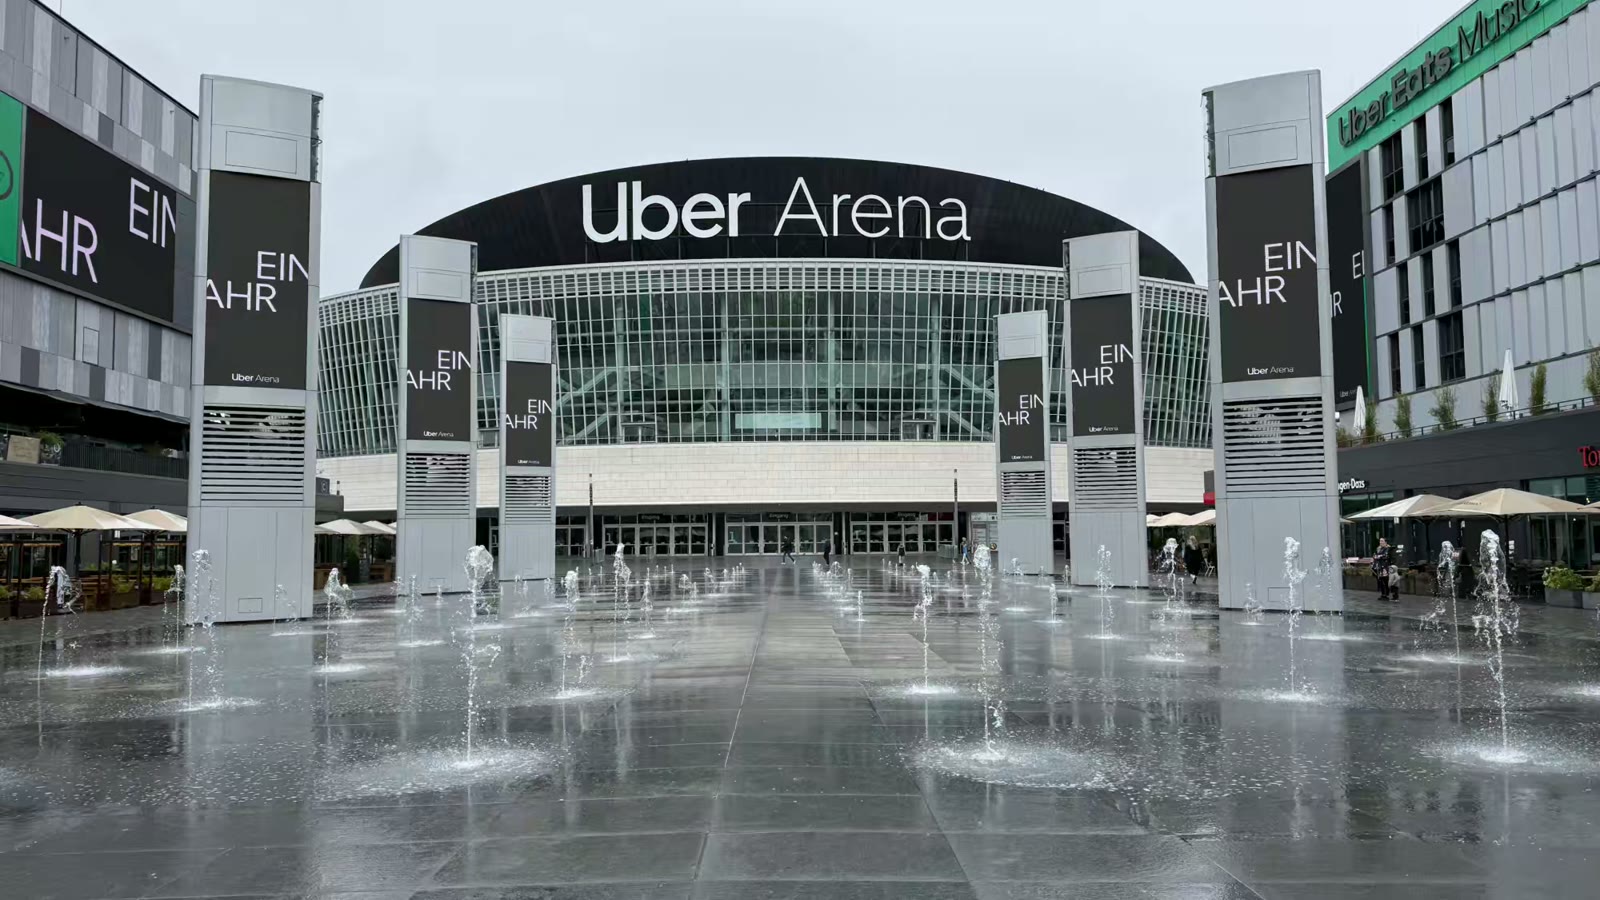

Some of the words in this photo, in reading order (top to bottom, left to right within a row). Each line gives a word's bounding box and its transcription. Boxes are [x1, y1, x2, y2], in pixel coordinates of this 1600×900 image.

[1338, 90, 1389, 148] Uber
[1391, 46, 1453, 110] Eats
[582, 181, 751, 243] Uber
[774, 176, 971, 241] Arena
[206, 279, 277, 313] AHR
[231, 373, 254, 382] Uber
[255, 374, 280, 383] Arena
[1247, 367, 1268, 375] Uber
[1270, 366, 1294, 374] Arena
[1338, 478, 1365, 493] gen-Dazs
